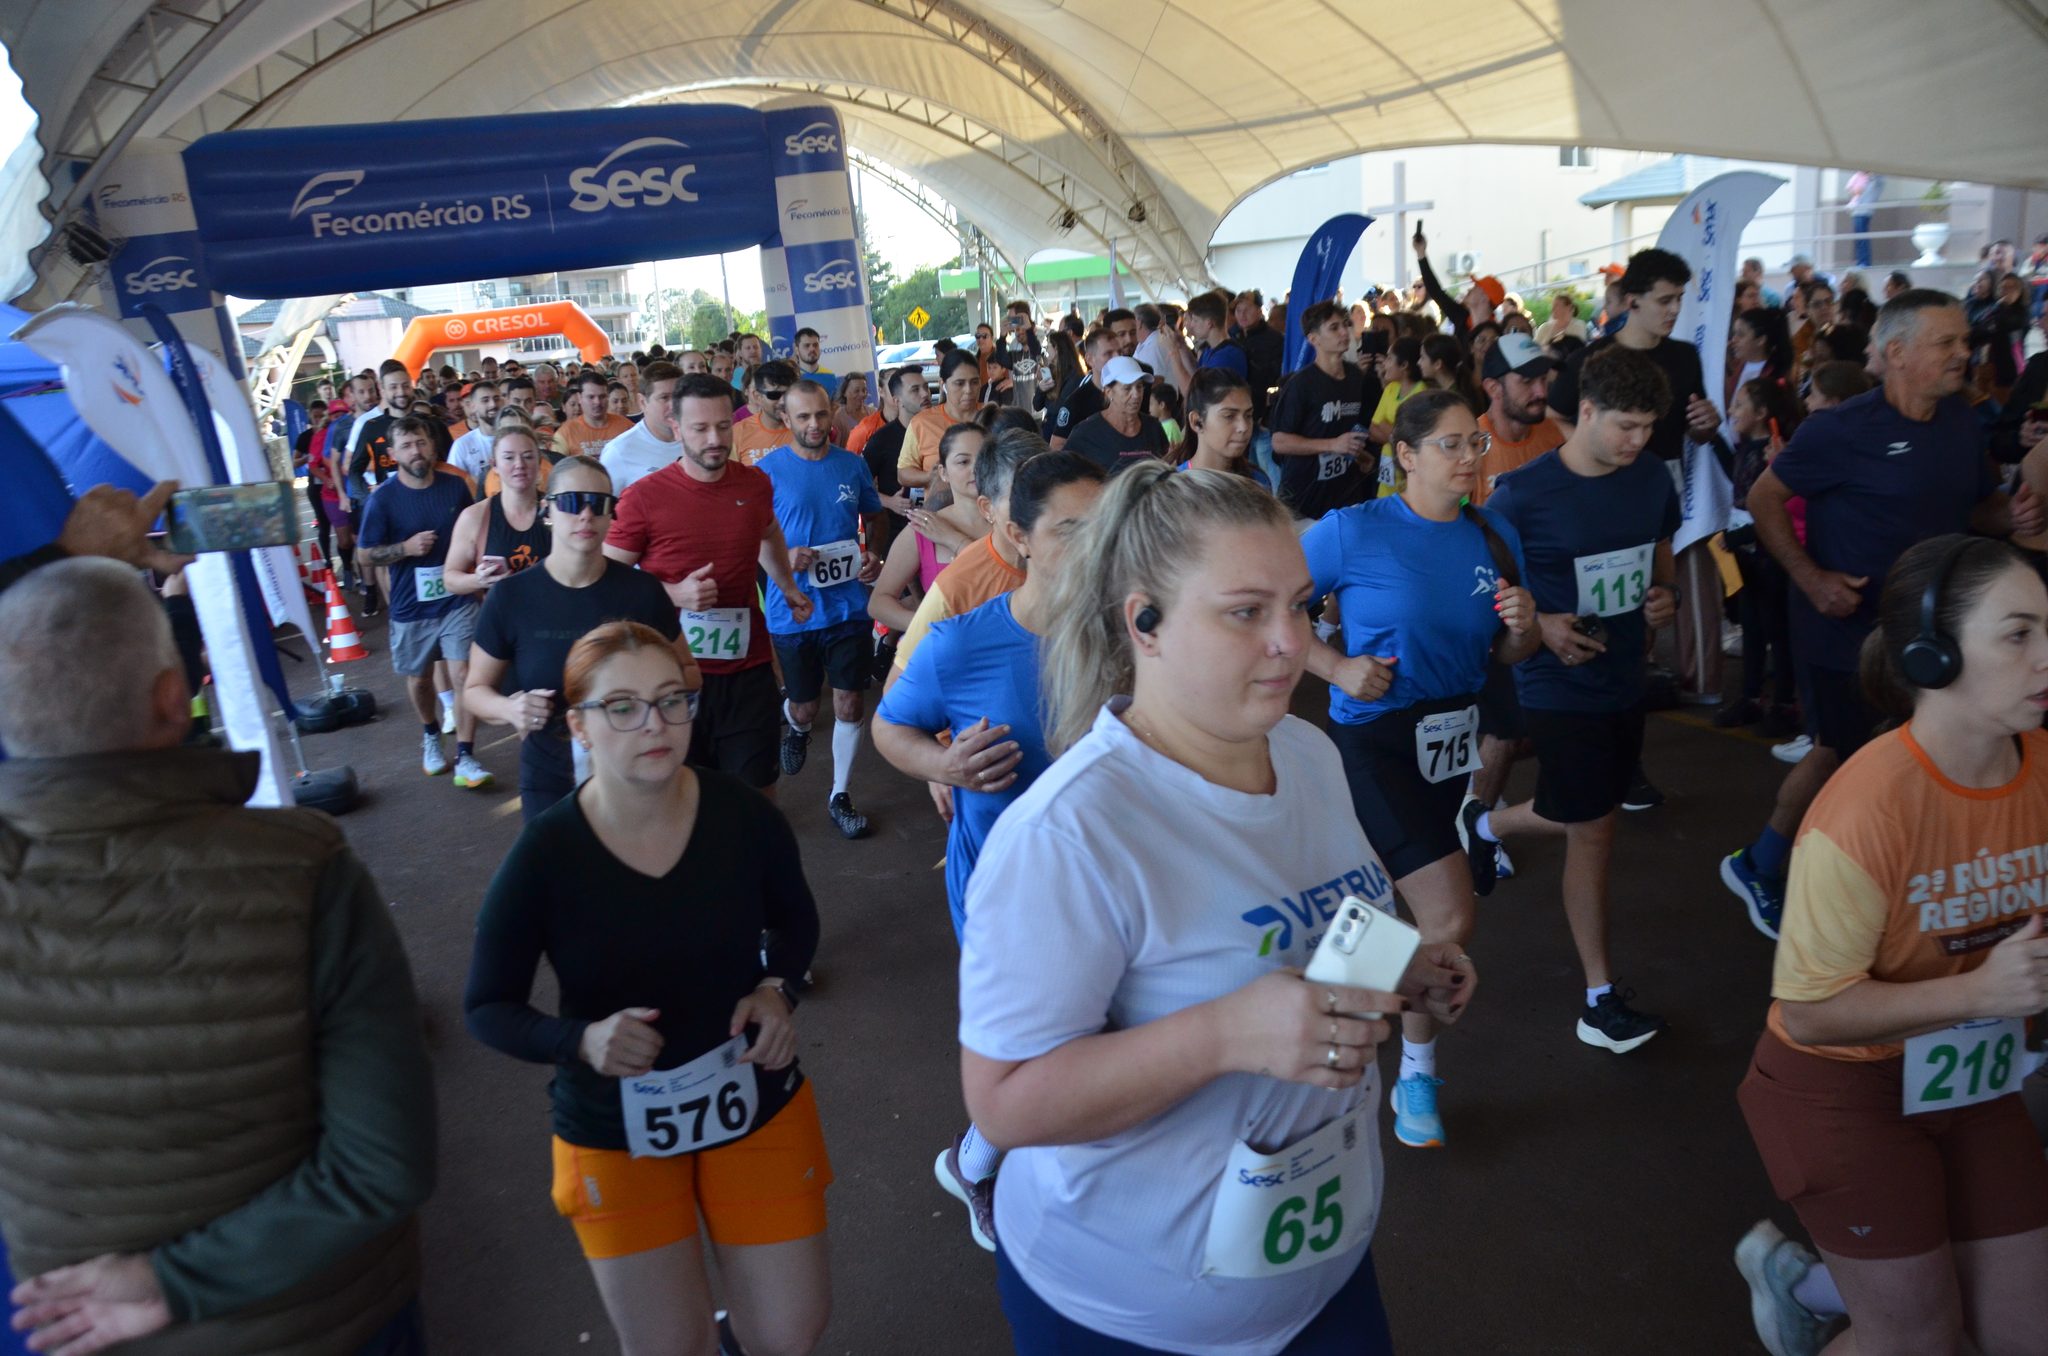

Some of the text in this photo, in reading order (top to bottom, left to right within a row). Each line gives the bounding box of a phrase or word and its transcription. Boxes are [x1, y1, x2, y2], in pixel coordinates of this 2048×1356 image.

[785, 133, 838, 156] Sesc
[569, 163, 699, 213] Sesc
[311, 193, 531, 239] Fecomércio RS
[790, 208, 841, 221] Fecomércio
[124, 268, 198, 295] Sesc
[804, 270, 857, 293] Sesc
[472, 312, 550, 334] CRESOL
[815, 554, 854, 584] 667
[1590, 569, 1645, 612] 113
[688, 625, 741, 656] 214
[1426, 731, 1471, 777] 715
[1919, 876, 2048, 933] REGION
[1919, 1032, 2015, 1102] 218
[645, 1080, 748, 1151] 576
[1238, 1168, 1286, 1188] Sesc
[1263, 1174, 1344, 1265] 65
